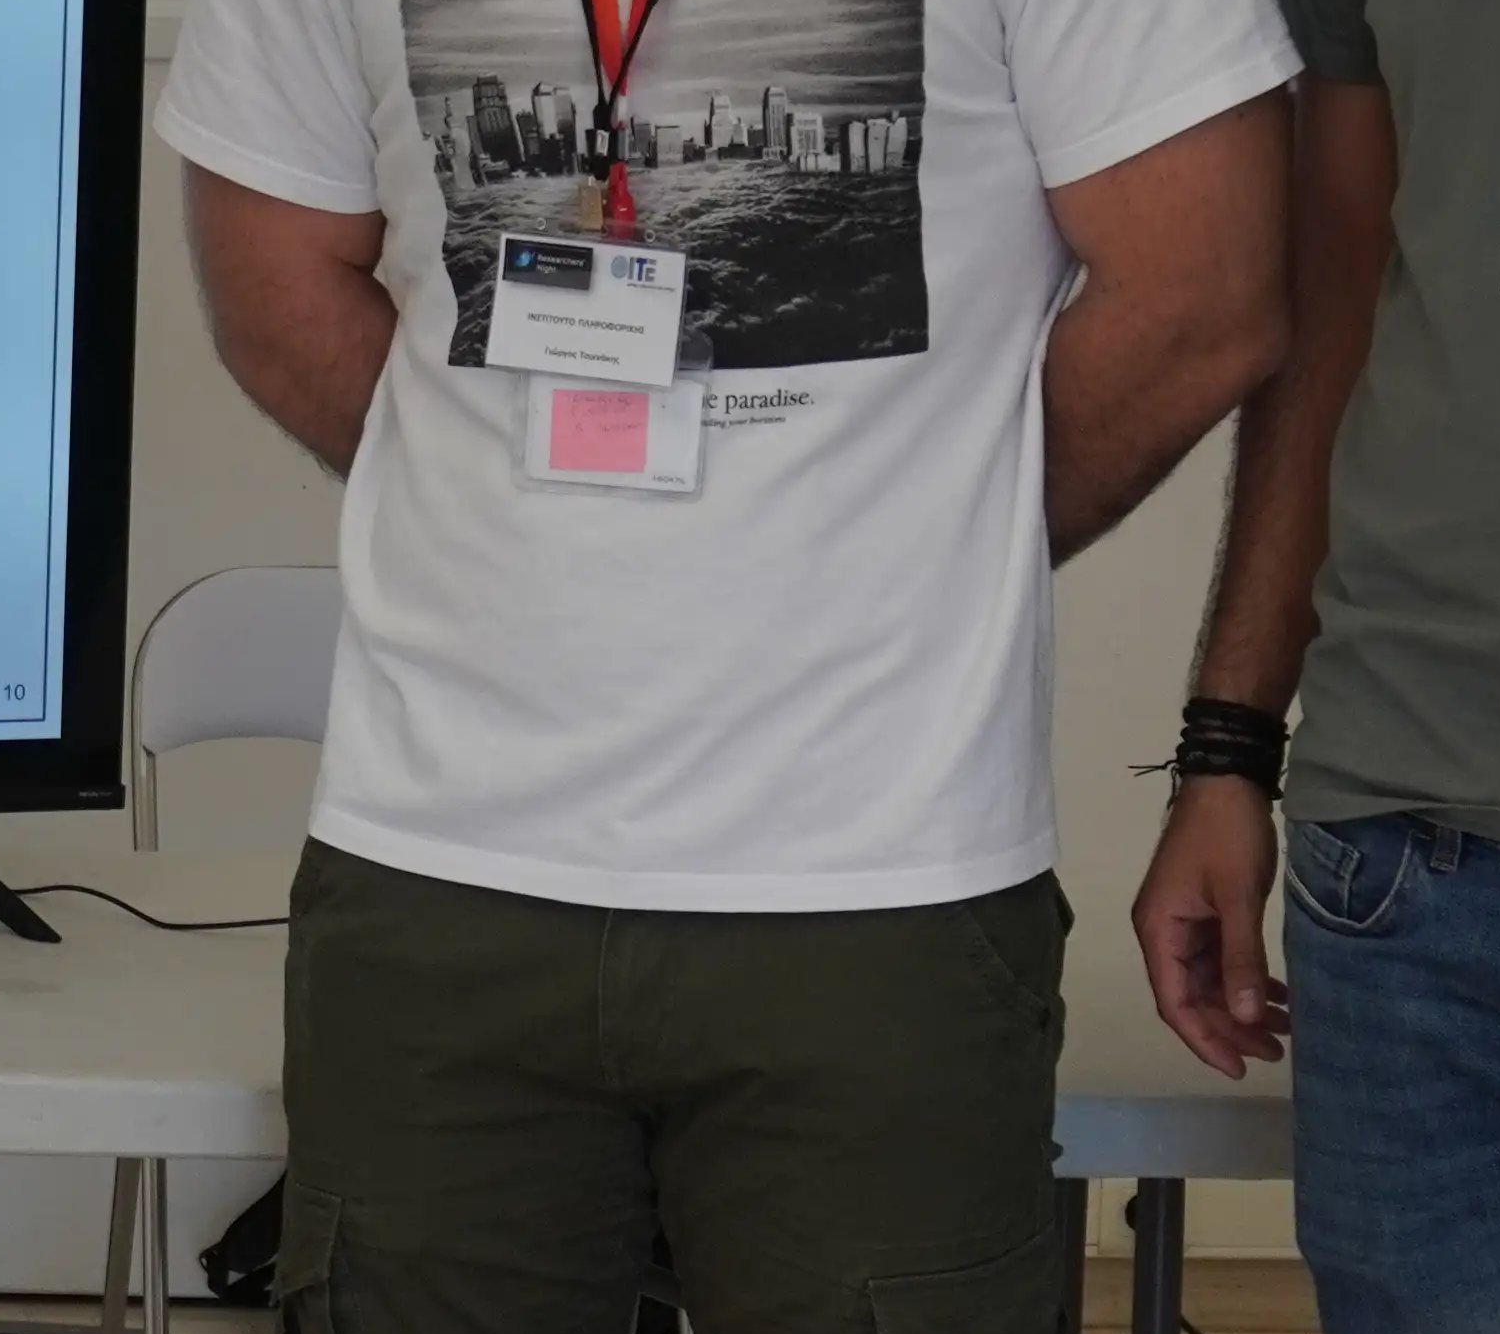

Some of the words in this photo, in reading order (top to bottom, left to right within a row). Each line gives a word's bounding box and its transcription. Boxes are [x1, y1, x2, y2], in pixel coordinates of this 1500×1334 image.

[527, 313, 576, 326] ΙΝΣΤΙΤΟΥΤΟ
[578, 320, 645, 334] ΠΛΗΡΟΦΟΡΙΚΗΣ
[725, 388, 815, 414] paradise.
[3, 683, 26, 701] 10
